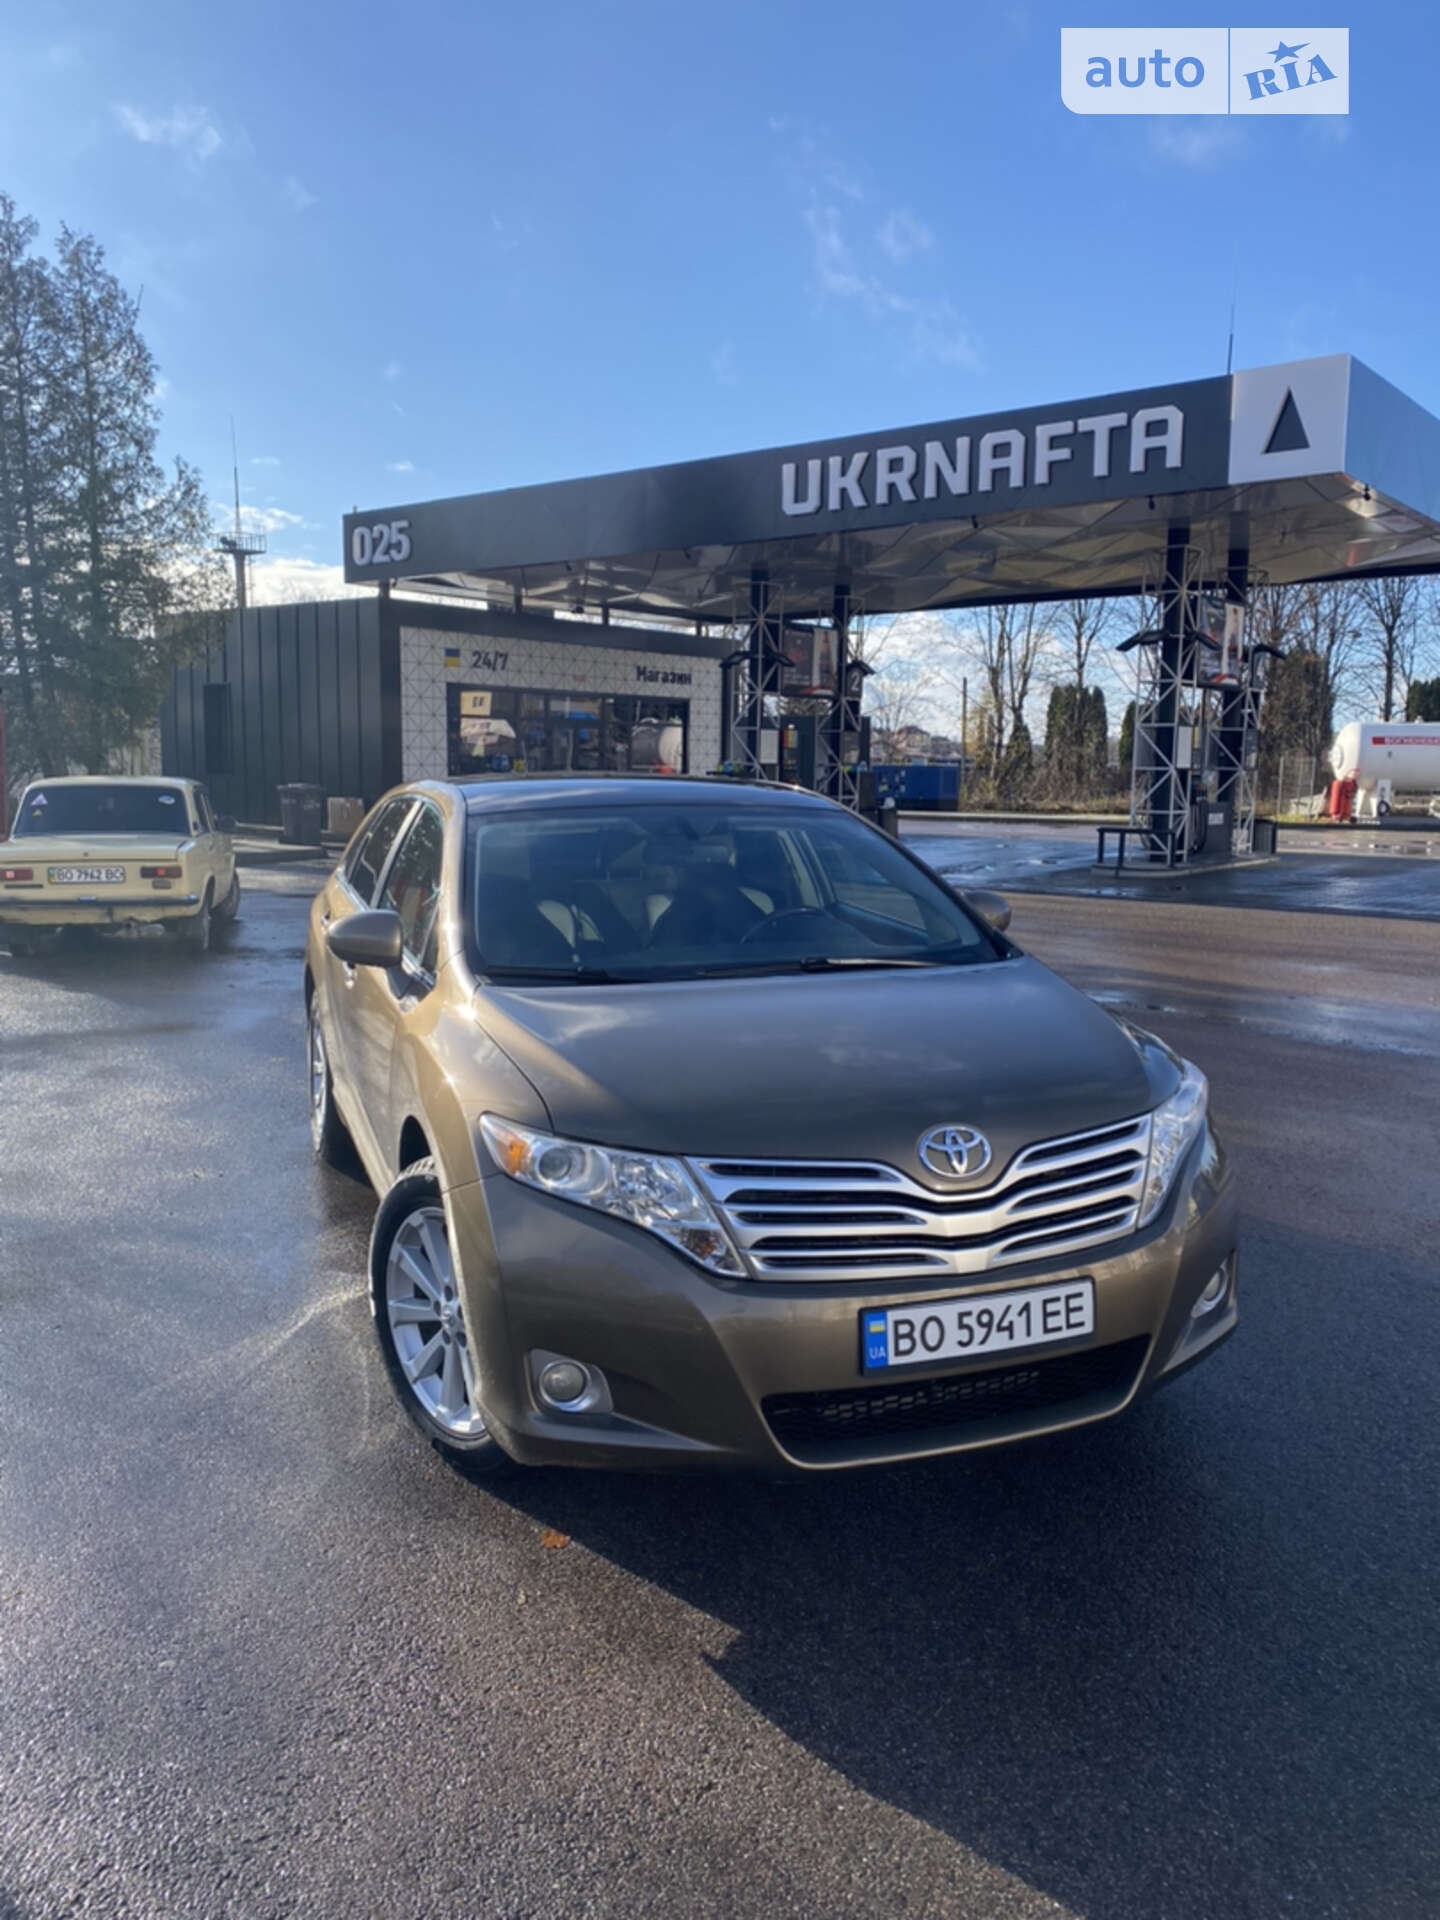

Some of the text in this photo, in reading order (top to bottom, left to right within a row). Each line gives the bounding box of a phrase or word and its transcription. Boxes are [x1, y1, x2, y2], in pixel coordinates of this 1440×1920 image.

[781, 404, 1184, 516] UKRNAFTA
[352, 520, 411, 566] 025
[472, 650, 508, 672] 24/7
[636, 665, 692, 685] Магазин
[893, 1291, 1085, 1357] BO 5941 EE
[869, 1346, 886, 1359] UA
